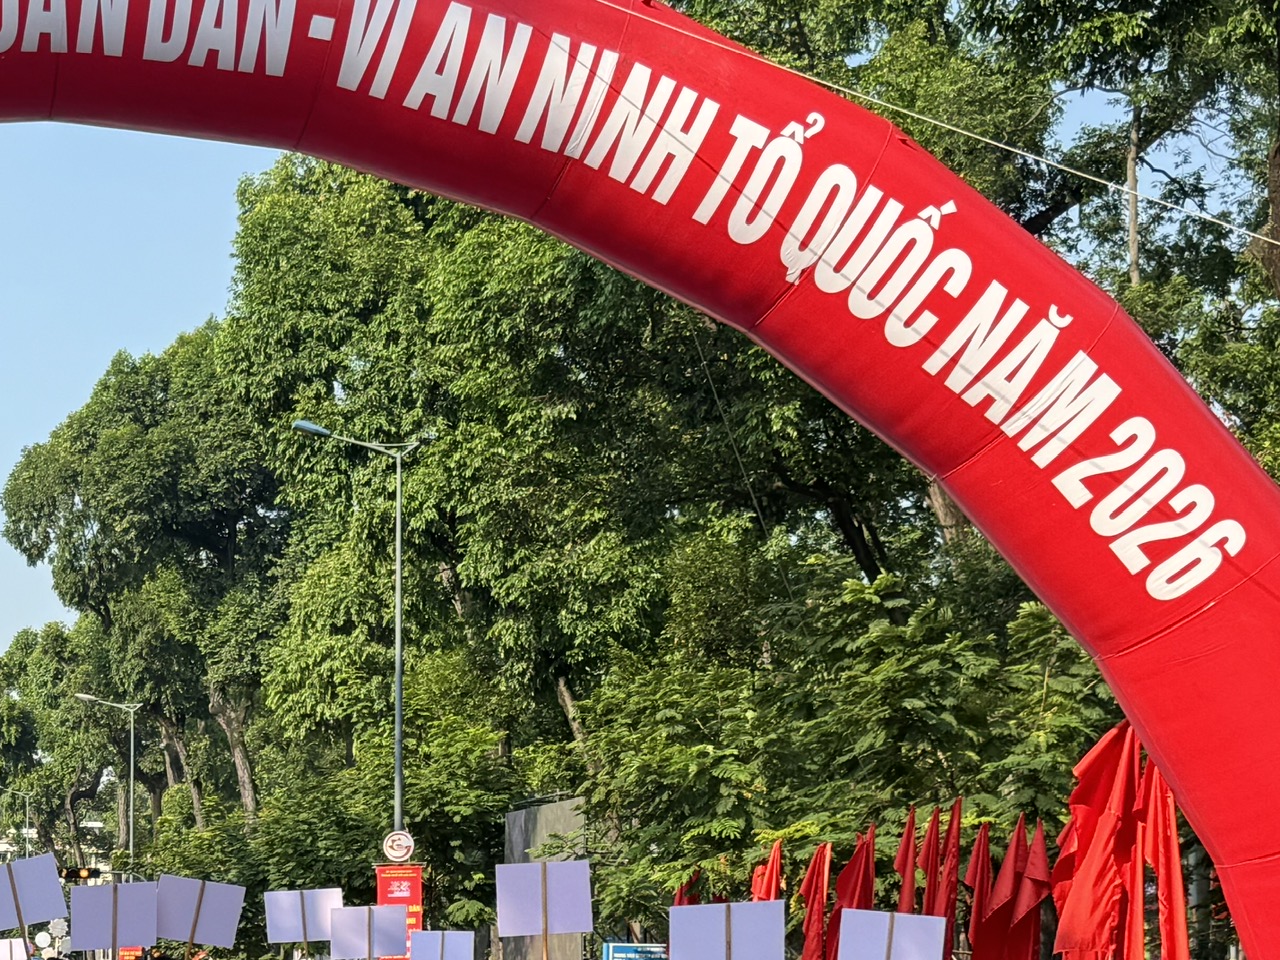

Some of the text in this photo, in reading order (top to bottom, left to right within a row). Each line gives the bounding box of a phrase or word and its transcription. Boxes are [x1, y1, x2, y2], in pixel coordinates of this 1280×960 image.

[402, 1, 533, 134] AN
[515, 33, 721, 205] NINH
[693, 112, 825, 245] TỔ
[780, 164, 973, 347] QUỐC
[922, 280, 1122, 469] NĂM
[1051, 416, 1247, 601] 2026
